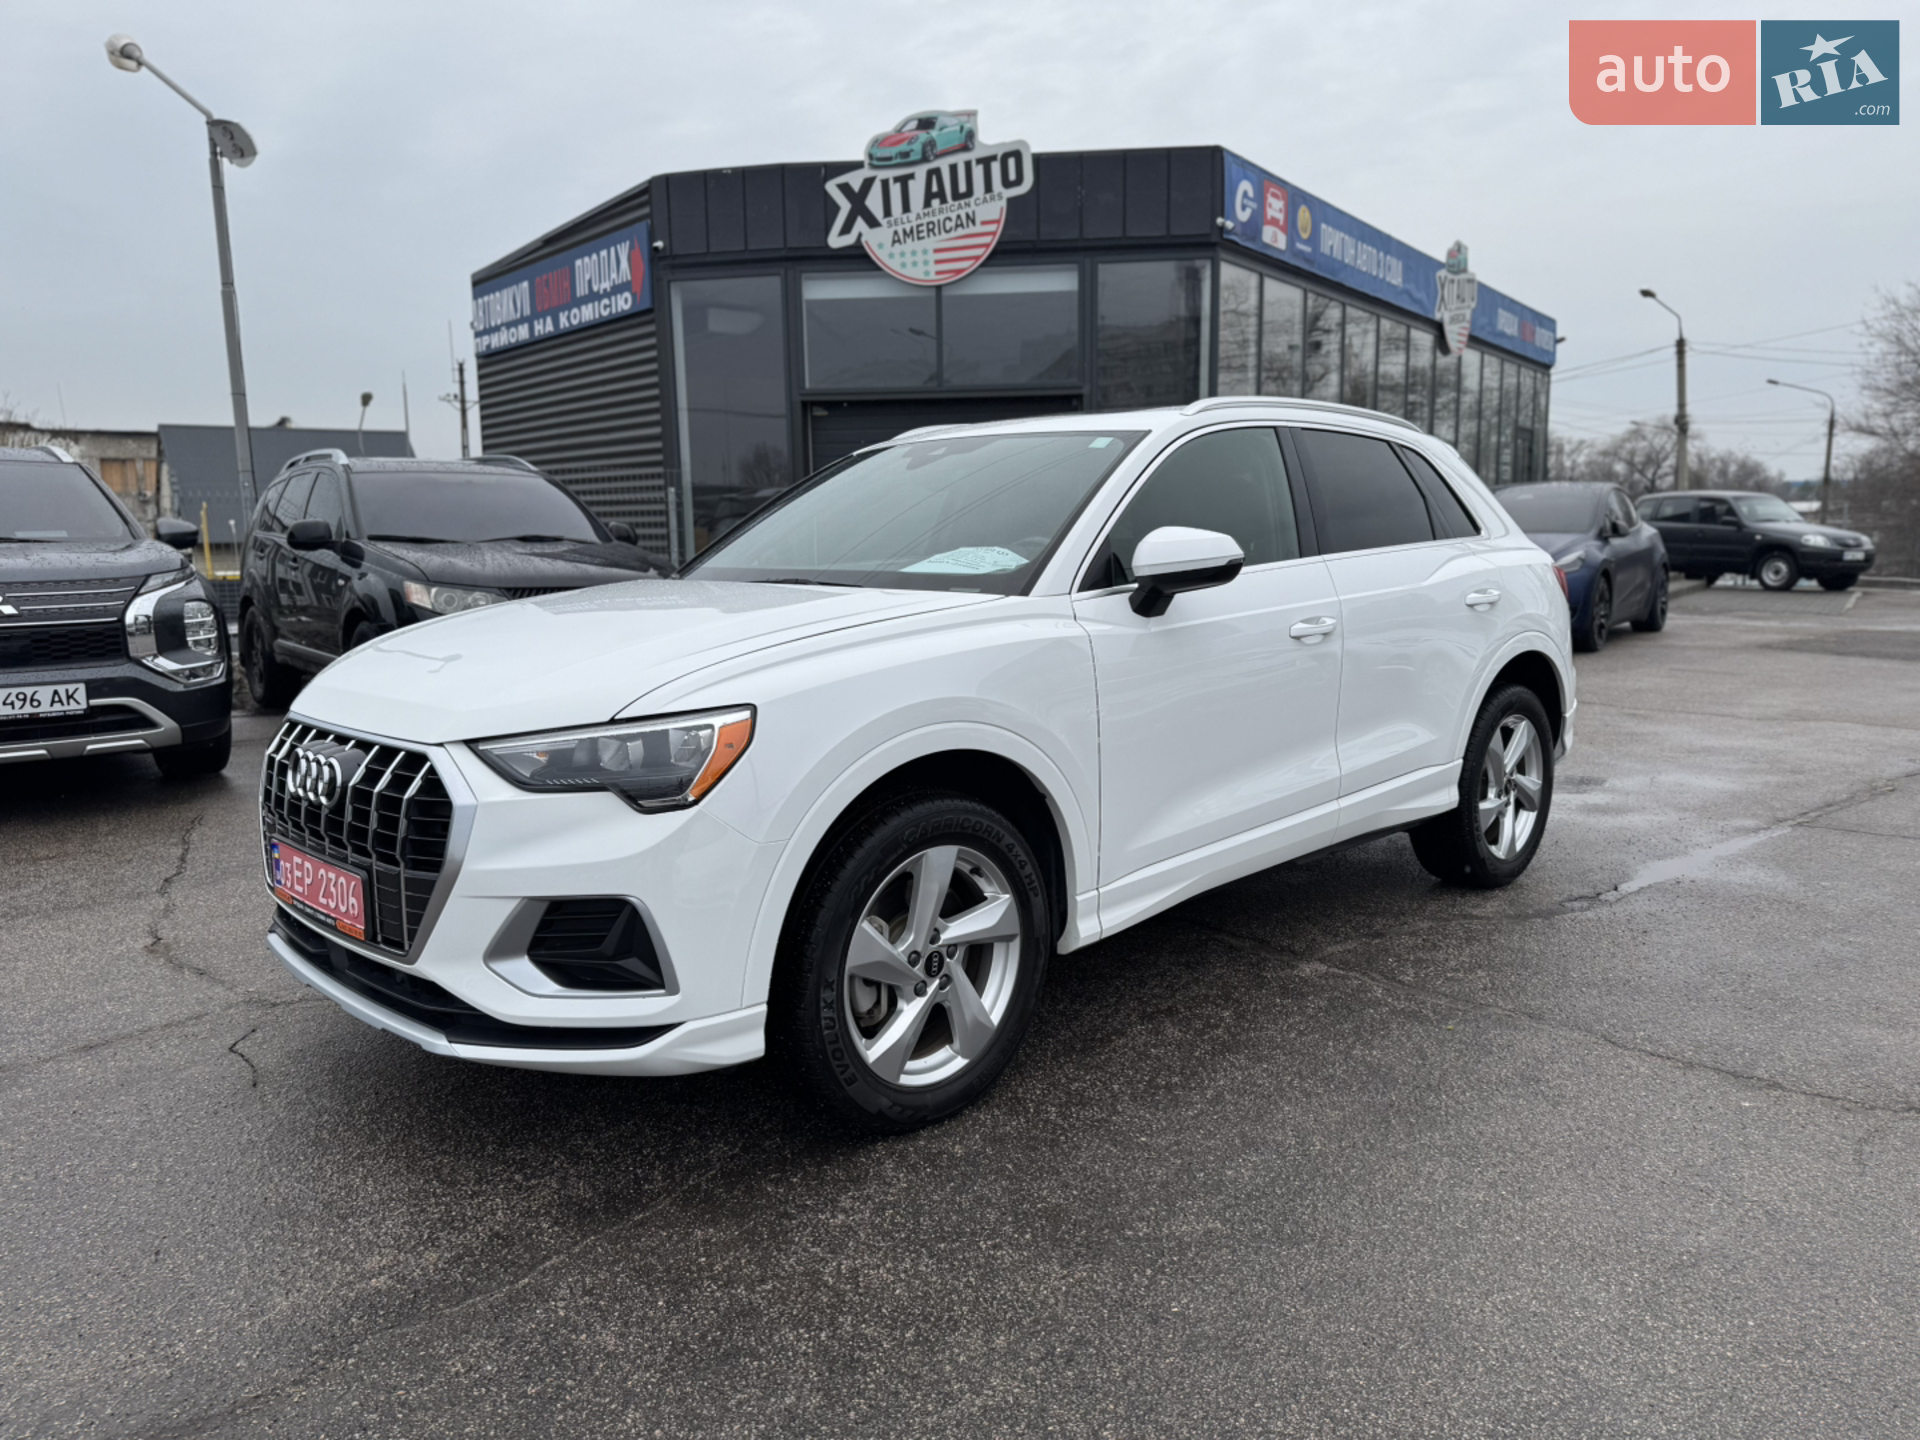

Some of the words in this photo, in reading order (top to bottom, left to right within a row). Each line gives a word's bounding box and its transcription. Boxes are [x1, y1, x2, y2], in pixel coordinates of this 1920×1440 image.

[886, 216, 913, 229] SELL
[915, 201, 972, 222] AMERICAN
[974, 192, 1004, 207] CARS
[891, 210, 977, 248] AMERICAN
[575, 240, 632, 298] ПРОДАЖ
[533, 318, 554, 337] НА
[559, 291, 632, 330] КОМІСІЮ
[2, 691, 42, 710] 496
[49, 687, 82, 707] AK
[904, 816, 1005, 844] CAPRICORN
[1024, 871, 1040, 898] HP
[318, 867, 359, 918] 2306
